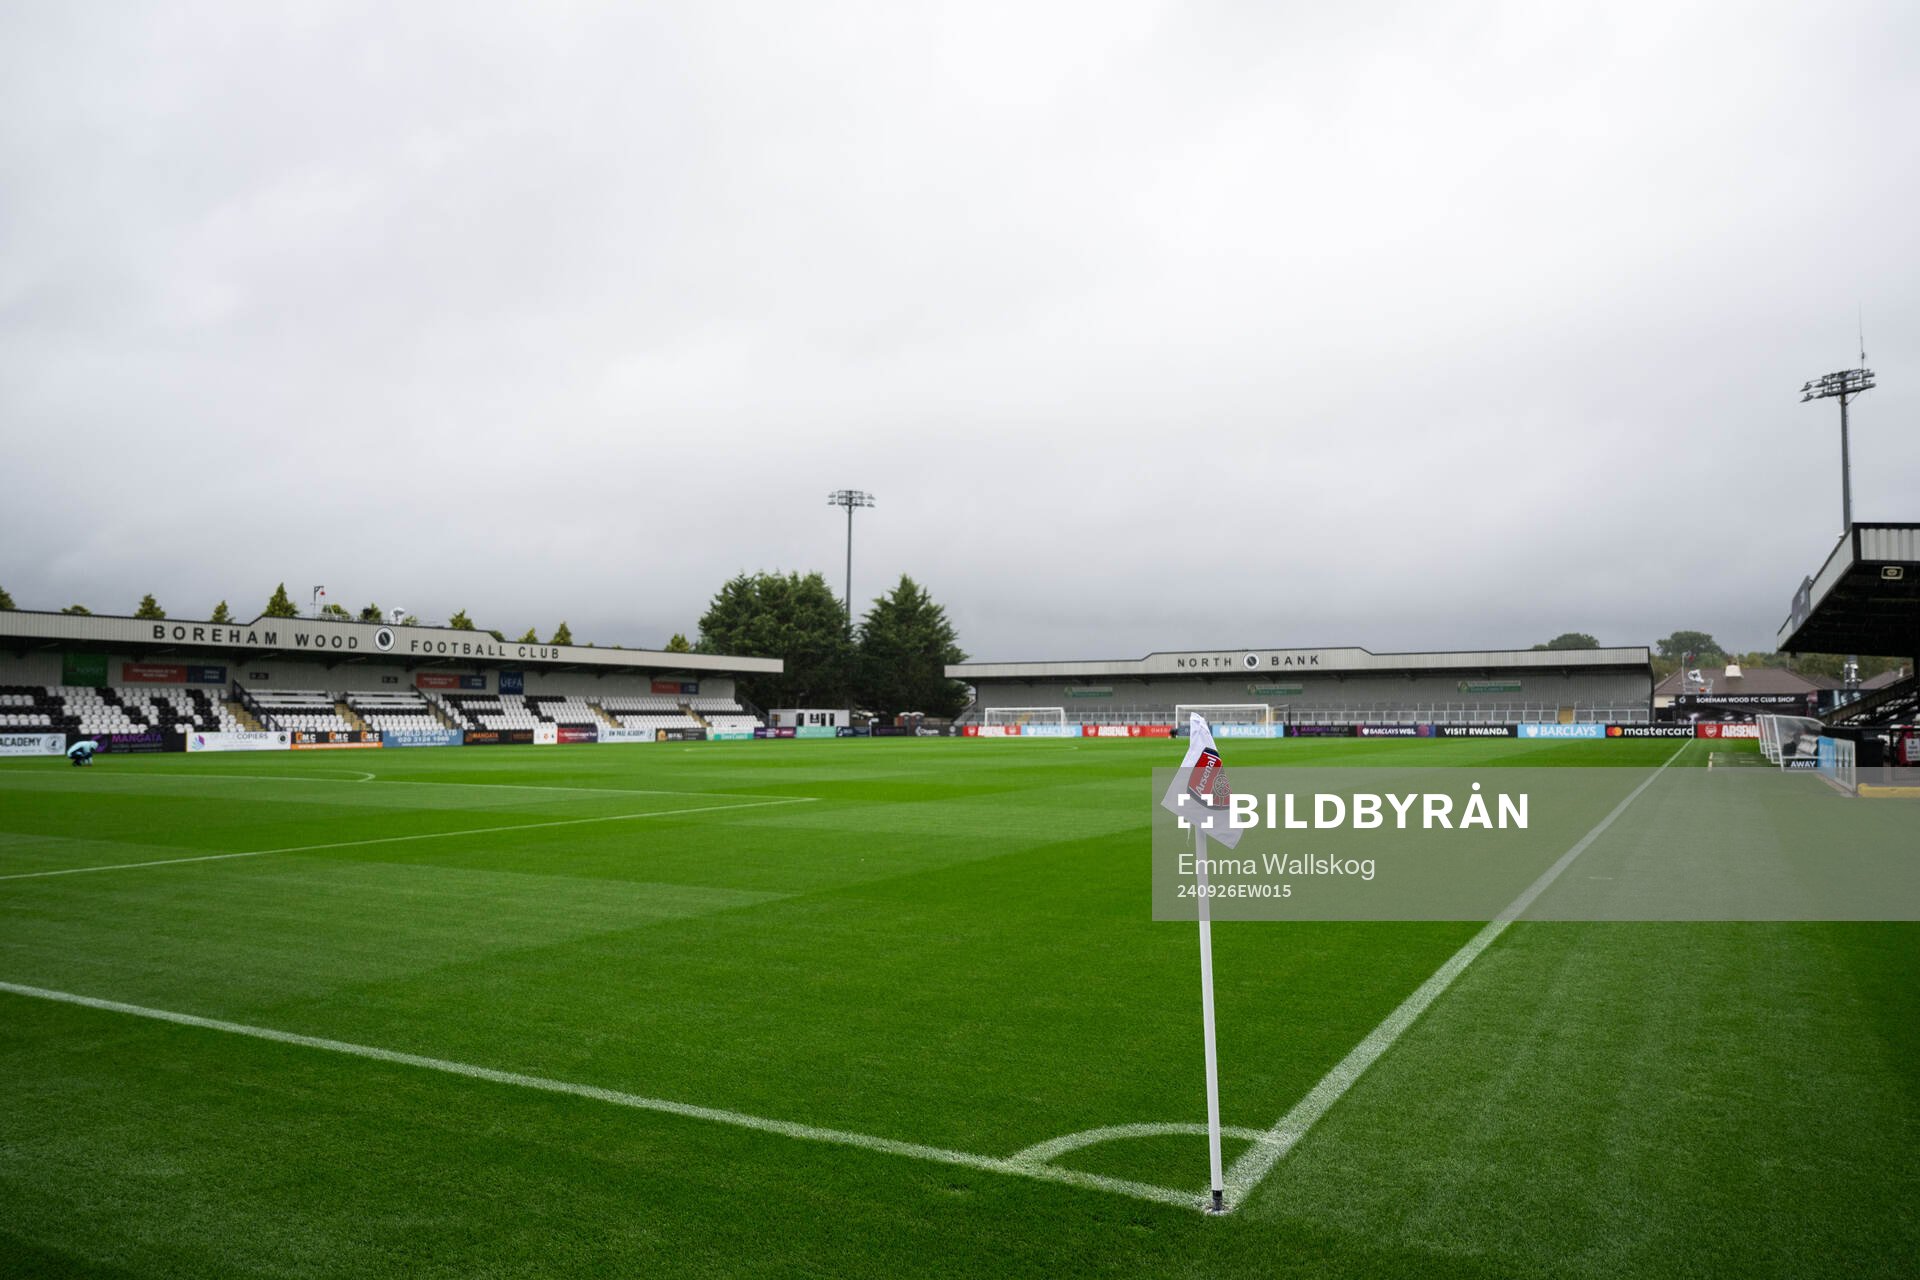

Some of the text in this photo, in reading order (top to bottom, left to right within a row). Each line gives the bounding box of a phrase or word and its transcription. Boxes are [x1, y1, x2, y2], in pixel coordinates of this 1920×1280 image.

[153, 624, 359, 649] BOREHAM WOOD
[410, 640, 560, 659] FOOTBALL CLUB
[1177, 654, 1320, 668] NORTH BANK
[1230, 725, 1277, 736] BARCLAYS
[1444, 727, 1509, 735] VISIT RWANDA
[1540, 726, 1597, 736] BARCLAYS
[1624, 726, 1694, 736] mastercard
[236, 732, 269, 740] COPIERS
[0, 737, 41, 747] ACADEMY
[1790, 760, 1816, 768] AWAY
[1195, 756, 1217, 794] Arsenal
